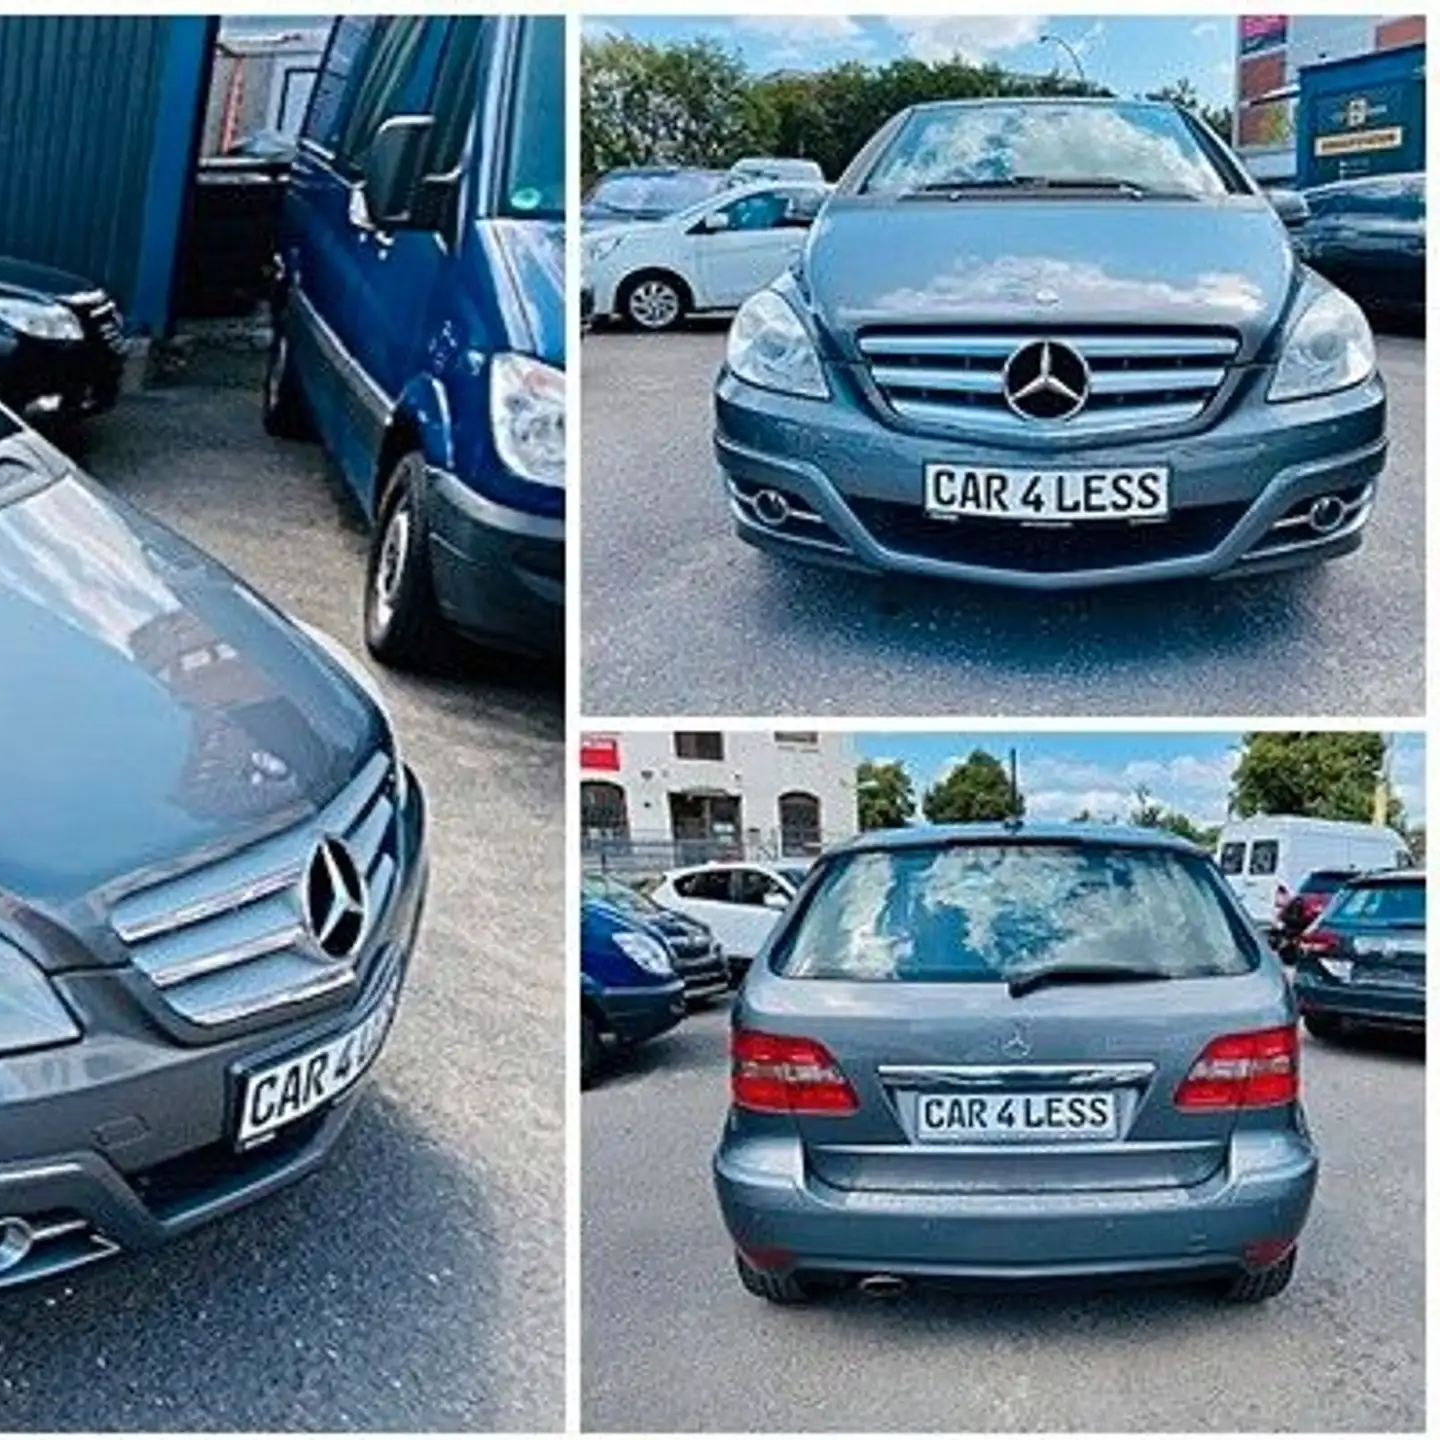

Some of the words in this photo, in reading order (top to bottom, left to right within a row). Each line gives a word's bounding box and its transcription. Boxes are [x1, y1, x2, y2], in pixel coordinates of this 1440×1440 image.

[933, 469, 1010, 512] CAR
[1021, 475, 1046, 513] 4
[1056, 472, 1161, 513] LESS
[251, 1051, 329, 1127] CAR
[924, 1097, 988, 1129] CAR
[996, 1098, 1016, 1129] 4
[1024, 1097, 1109, 1129] LESS
